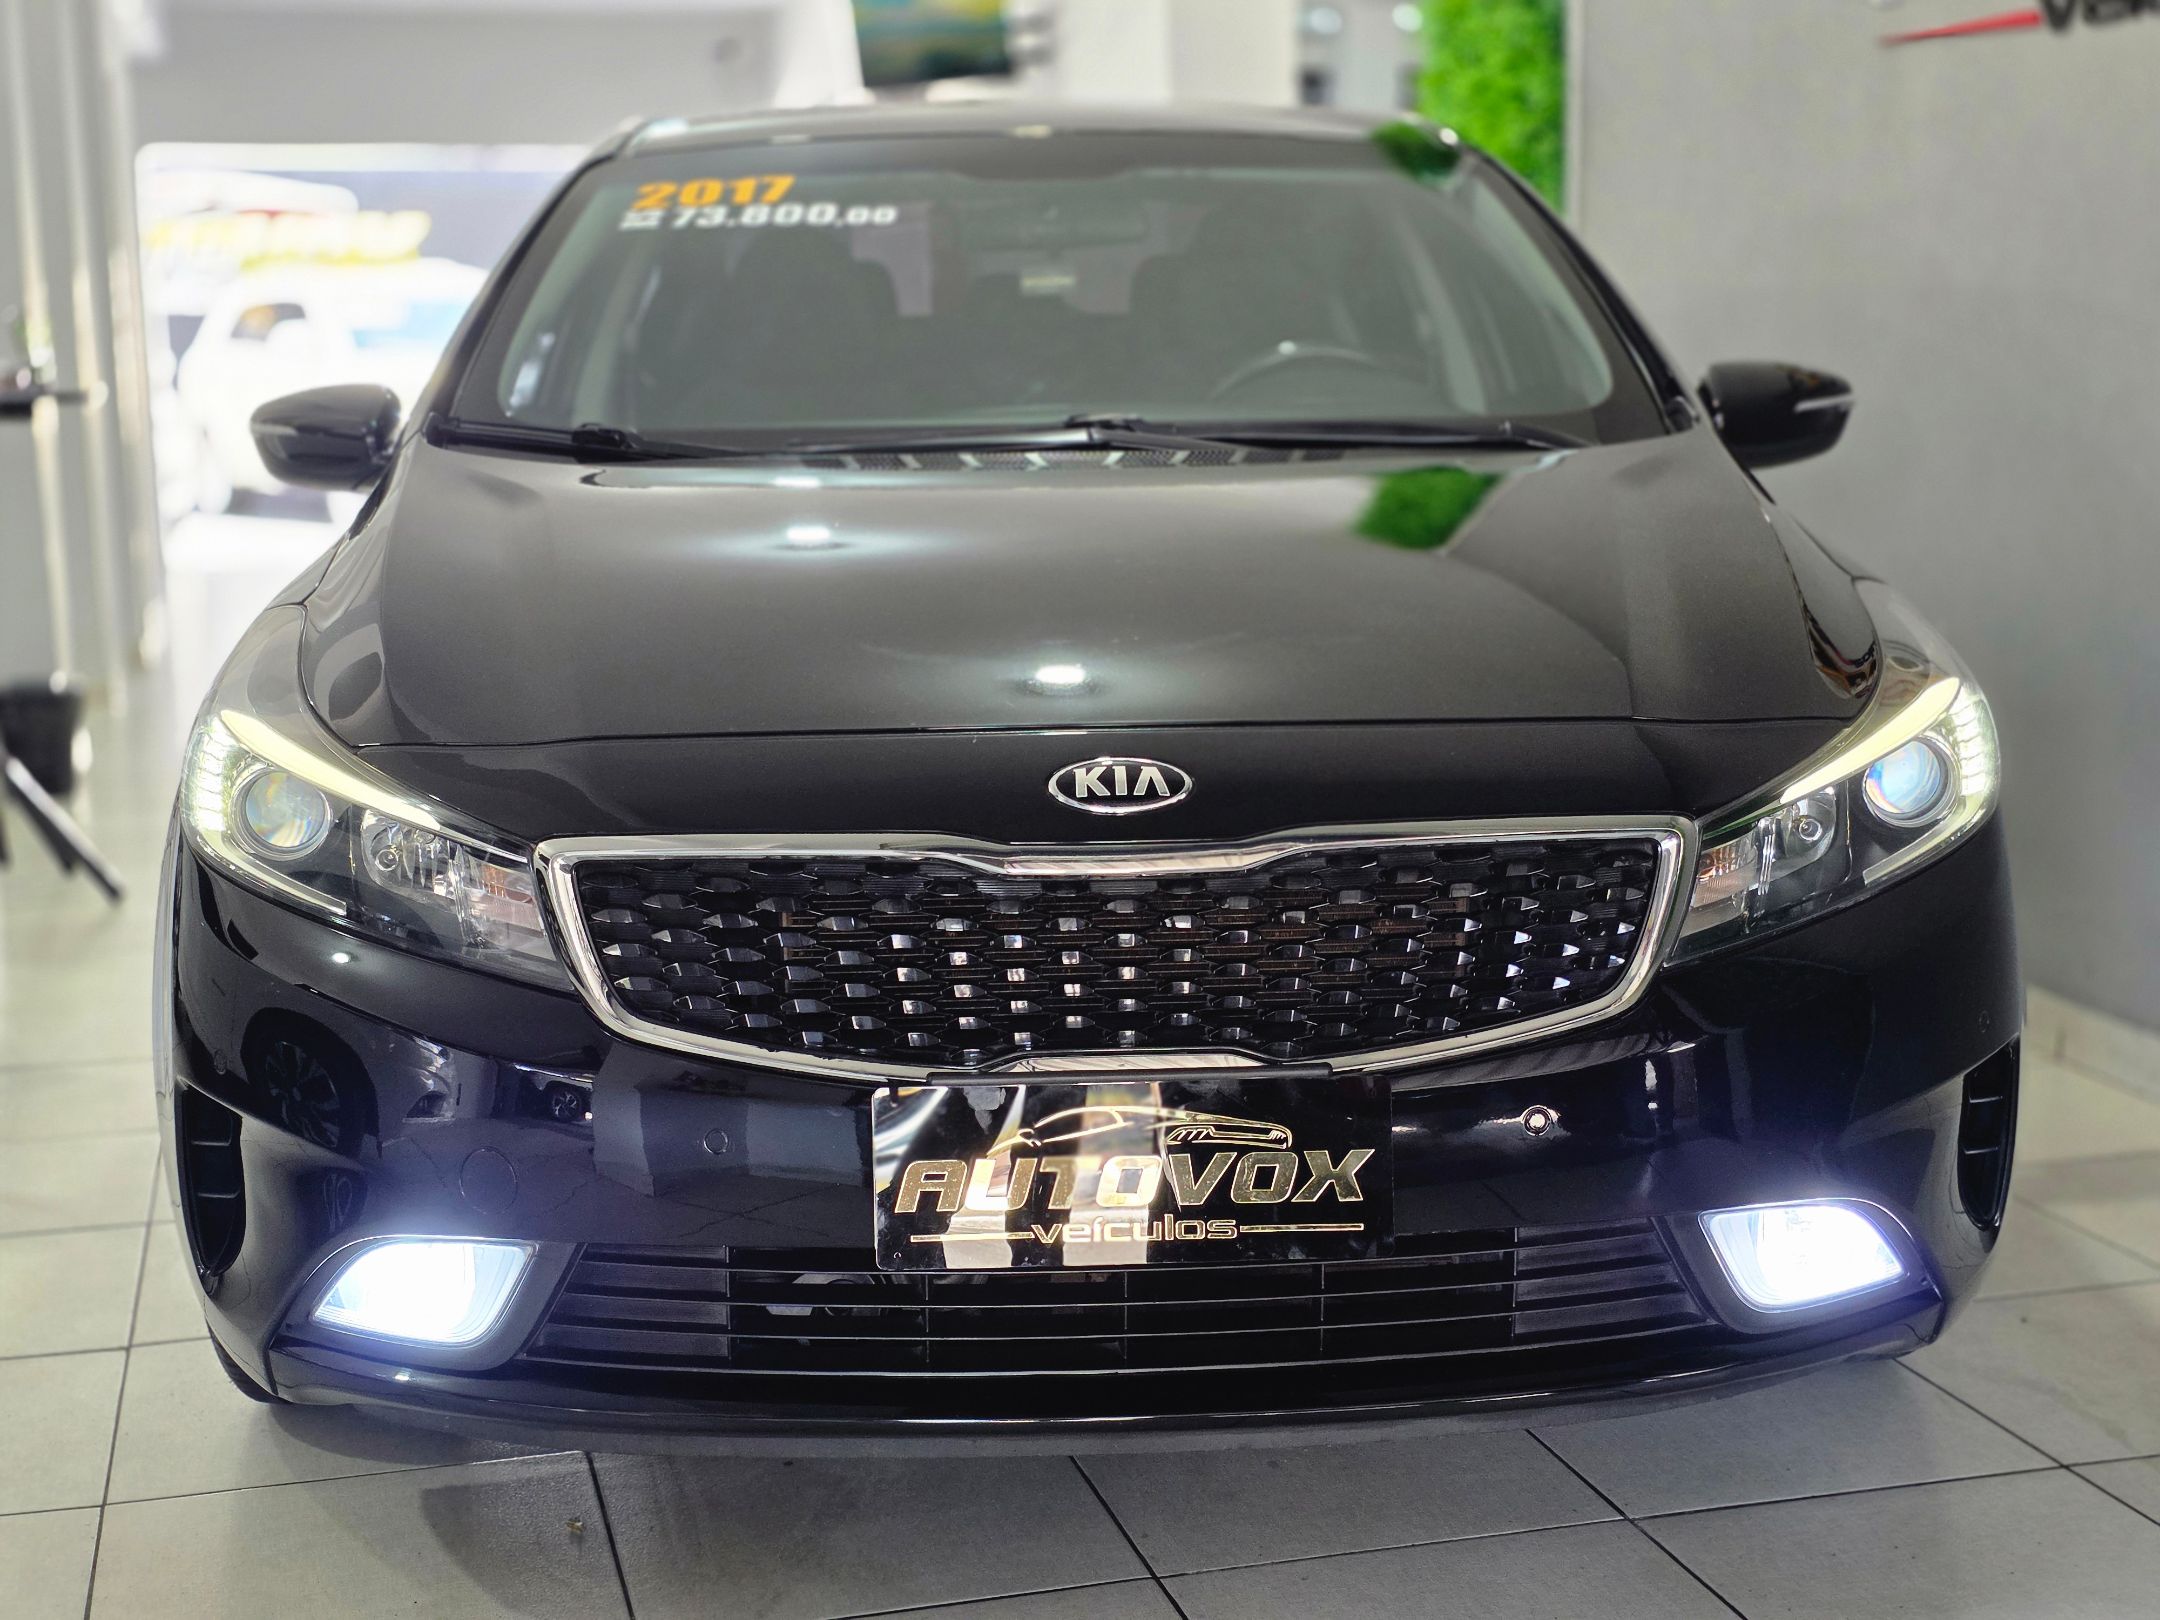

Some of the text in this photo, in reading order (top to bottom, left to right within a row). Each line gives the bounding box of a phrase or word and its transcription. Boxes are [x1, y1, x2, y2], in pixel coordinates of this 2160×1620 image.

[633, 174, 795, 210] 2017
[1073, 765, 1171, 798] KIA
[894, 1148, 1376, 1213] AUTOVOX
[1031, 1213, 1239, 1244] veículos
